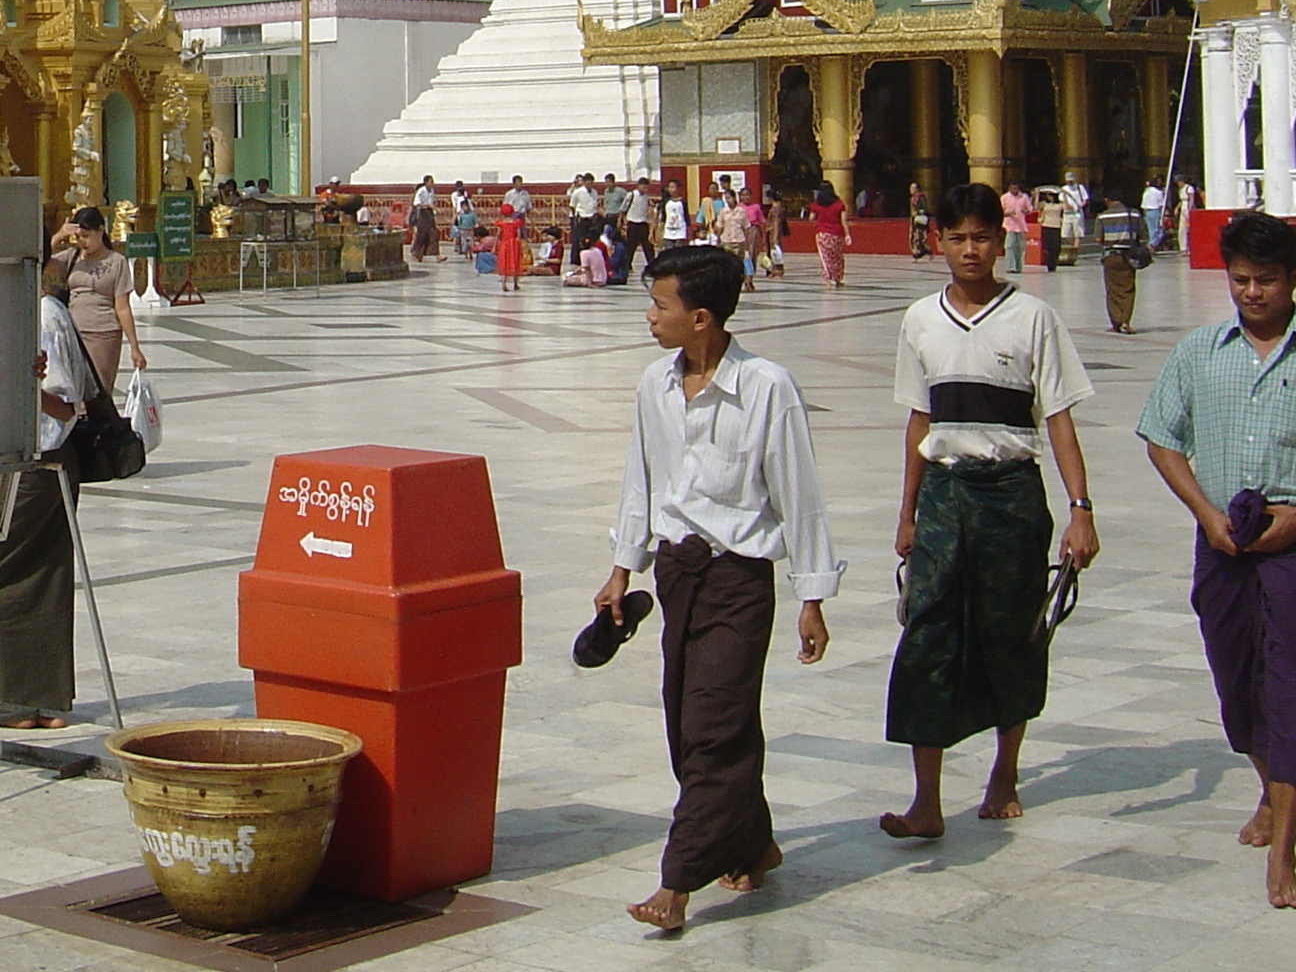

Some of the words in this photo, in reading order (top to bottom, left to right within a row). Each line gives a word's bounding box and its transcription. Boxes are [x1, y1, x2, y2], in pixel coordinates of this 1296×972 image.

[278, 476, 375, 527] အမှိုက်စွန့်ရန်
